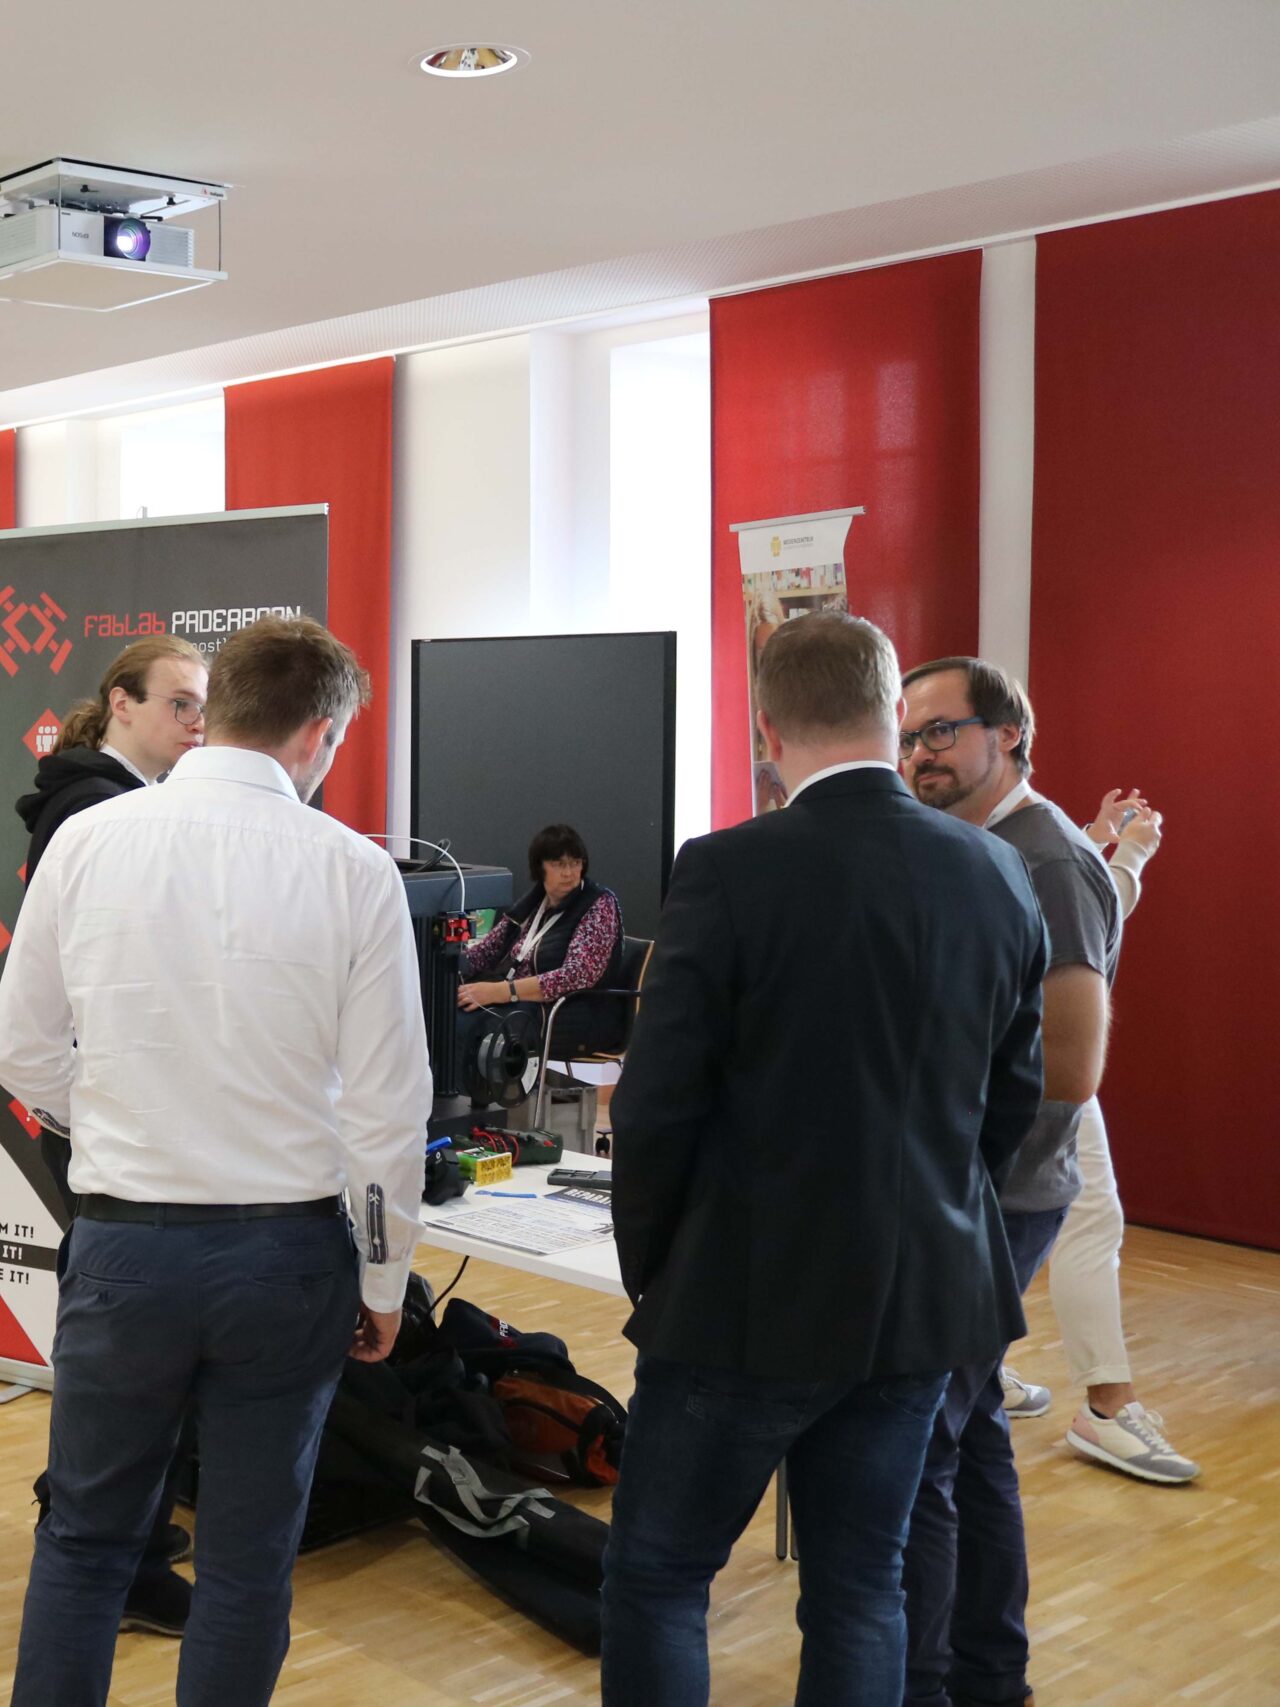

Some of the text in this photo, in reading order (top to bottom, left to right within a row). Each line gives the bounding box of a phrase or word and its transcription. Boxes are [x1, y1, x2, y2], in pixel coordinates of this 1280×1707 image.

[14, 1224, 34, 1239] IT!
[2, 1245, 23, 1260] IT!
[9, 1270, 29, 1285] IT!
